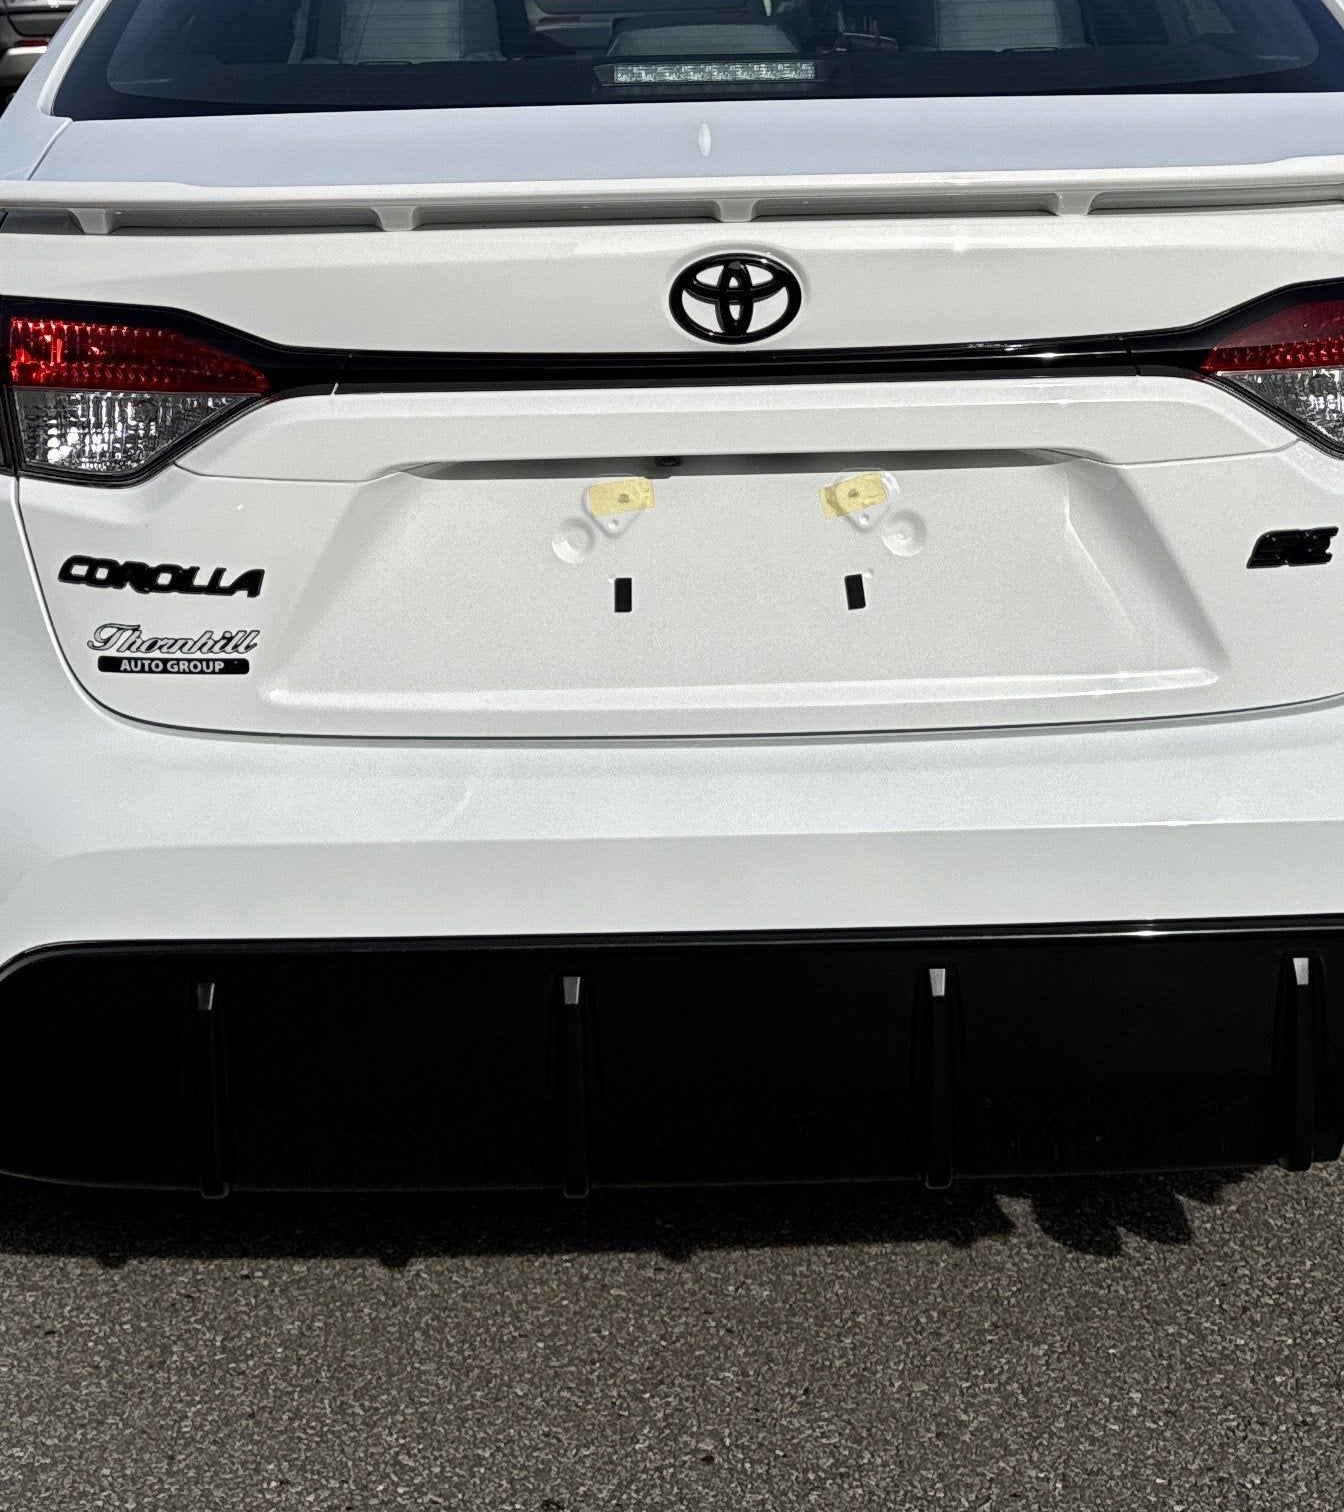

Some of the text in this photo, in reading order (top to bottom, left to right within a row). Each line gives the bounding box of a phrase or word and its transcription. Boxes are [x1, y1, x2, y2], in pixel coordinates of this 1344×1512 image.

[58, 554, 265, 598] COROLLA
[87, 623, 261, 654] Thornhill
[119, 658, 225, 673] AUTO GROUP
